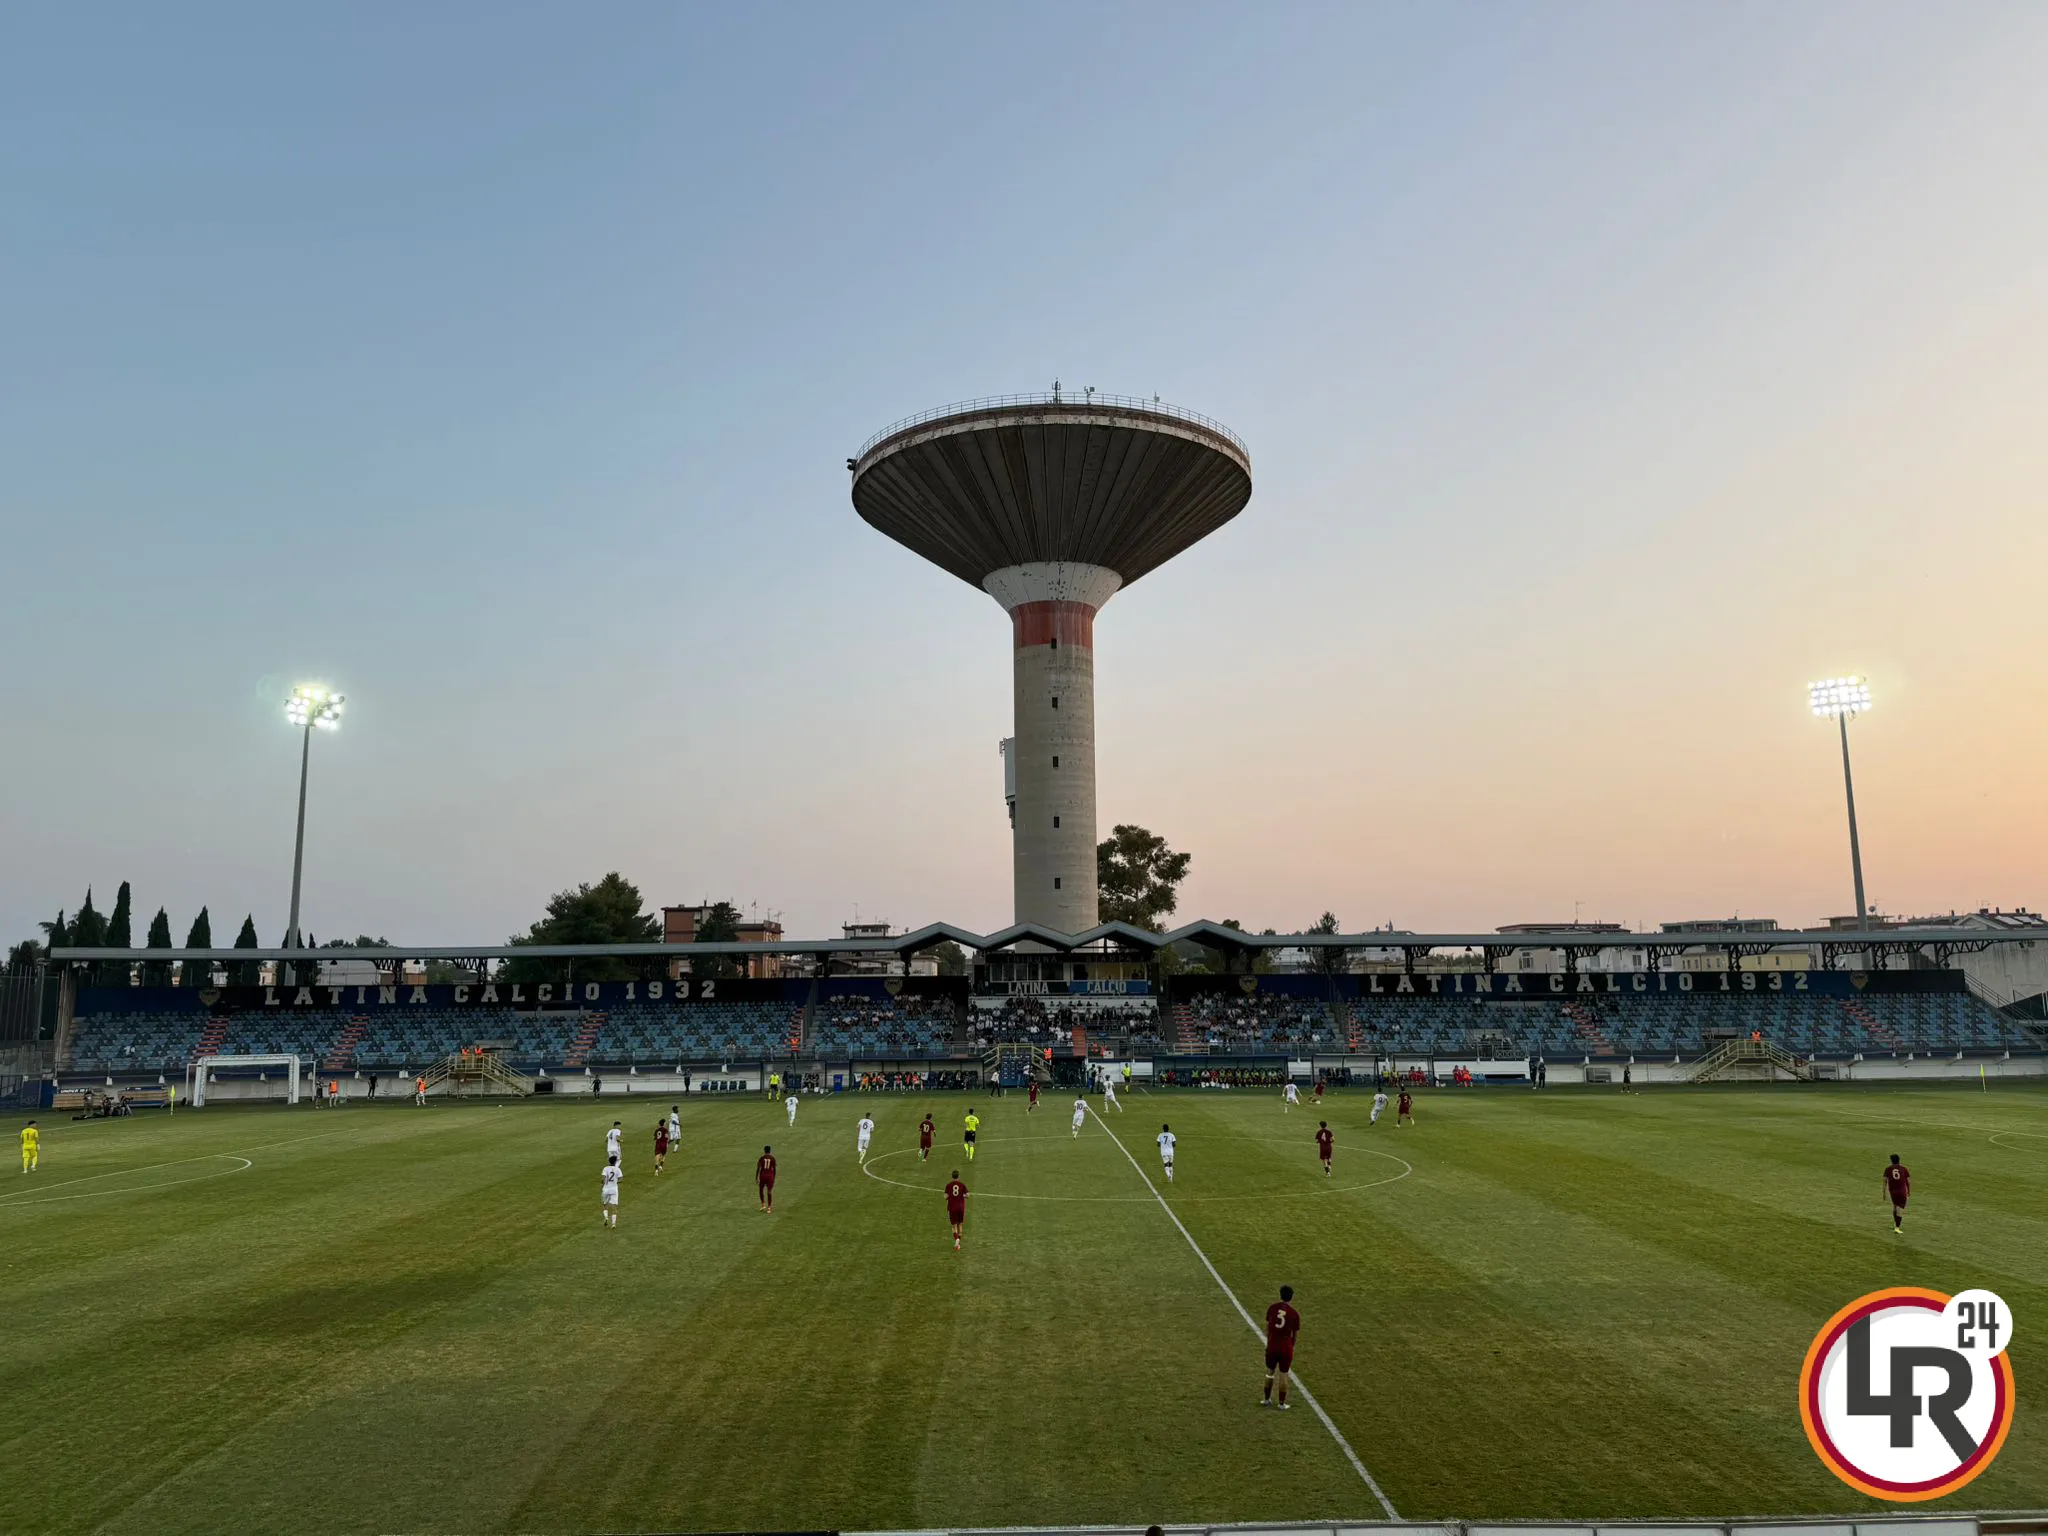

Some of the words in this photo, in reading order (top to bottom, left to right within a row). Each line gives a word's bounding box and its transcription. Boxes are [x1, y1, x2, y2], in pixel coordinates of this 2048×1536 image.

[1008, 981, 1050, 995] LATINA
[1087, 981, 1127, 994] CALCIO
[1369, 974, 1524, 993] LATINA
[1549, 973, 1693, 992] CALCIO
[1720, 972, 1809, 991] 1932
[264, 985, 428, 1006] LATINA
[454, 982, 601, 1003] CALCIO
[626, 979, 716, 1000] 1932
[1076, 1102, 1083, 1111] 10
[923, 1123, 931, 1133] 10
[1163, 1135, 1169, 1145] 7
[1321, 1132, 1327, 1142] 4
[763, 1157, 771, 1169] 11
[608, 1171, 615, 1182] 2
[1892, 1168, 1901, 1181] 6
[952, 1184, 960, 1197] 8
[1275, 1308, 1287, 1329] 3
